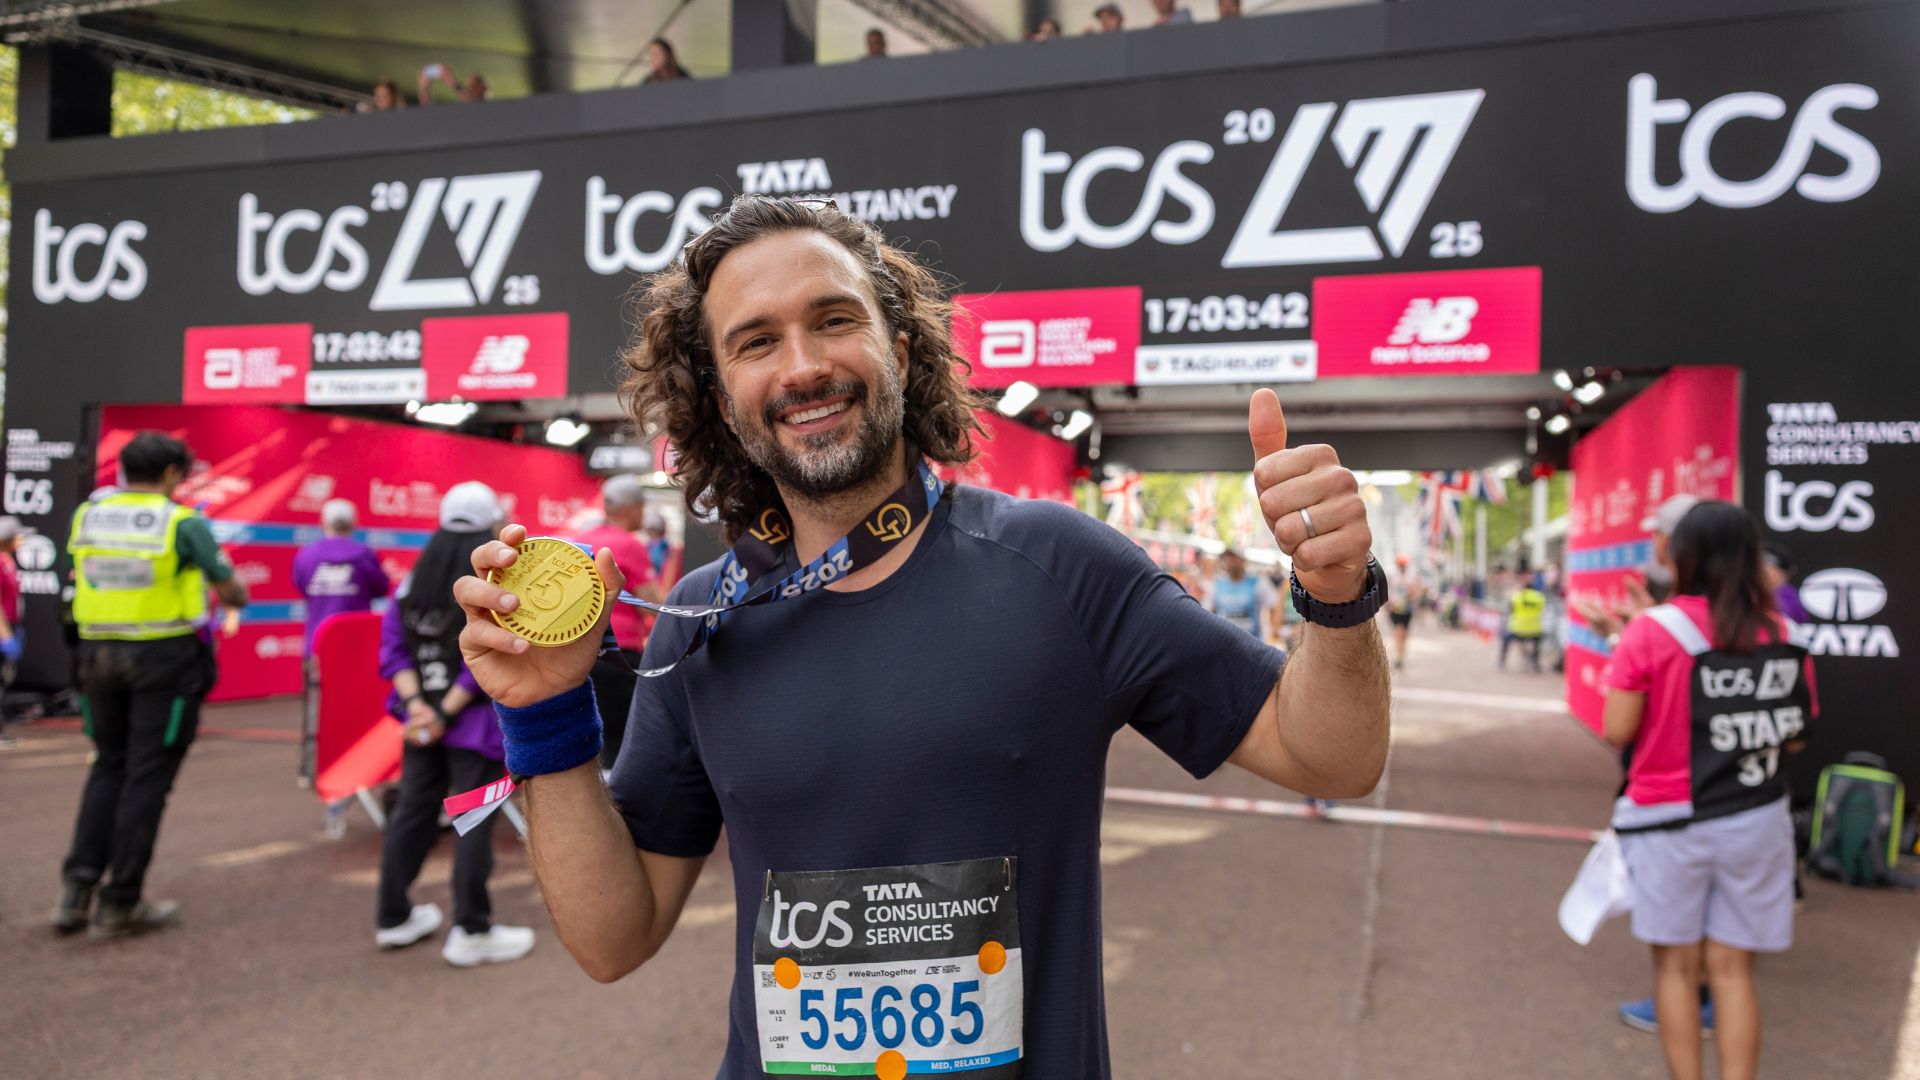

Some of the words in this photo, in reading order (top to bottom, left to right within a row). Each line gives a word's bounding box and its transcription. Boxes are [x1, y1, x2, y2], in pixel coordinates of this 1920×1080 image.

[1223, 107, 1275, 144] 20
[1626, 73, 1881, 213] tcs
[737, 158, 832, 193] TATA
[1020, 128, 1215, 252] tcs
[372, 182, 408, 211] 20
[32, 207, 148, 304] tcs
[237, 192, 369, 295] tcs
[1430, 221, 1482, 259] 25
[503, 275, 540, 306] 25
[1145, 292, 1309, 333] 17:03:42
[313, 330, 421, 362] 17:03:42
[1767, 402, 1838, 423] TATA
[1766, 442, 1868, 465] SERVICES
[4, 472, 53, 514] tcs
[1765, 469, 1875, 532] tcs
[782, 549, 853, 598] 2025
[1700, 665, 1755, 698] tcs
[1709, 706, 1804, 751] STAFF
[863, 882, 922, 901] TATA
[864, 896, 999, 923] CONSULTANCY
[770, 889, 853, 949] tcs
[866, 924, 954, 946] SERVICES
[848, 968, 917, 978] #WeRunTogether
[800, 979, 984, 1051] 55685
[811, 1064, 837, 1072] MEDAL
[954, 1057, 991, 1068] RELAXED
